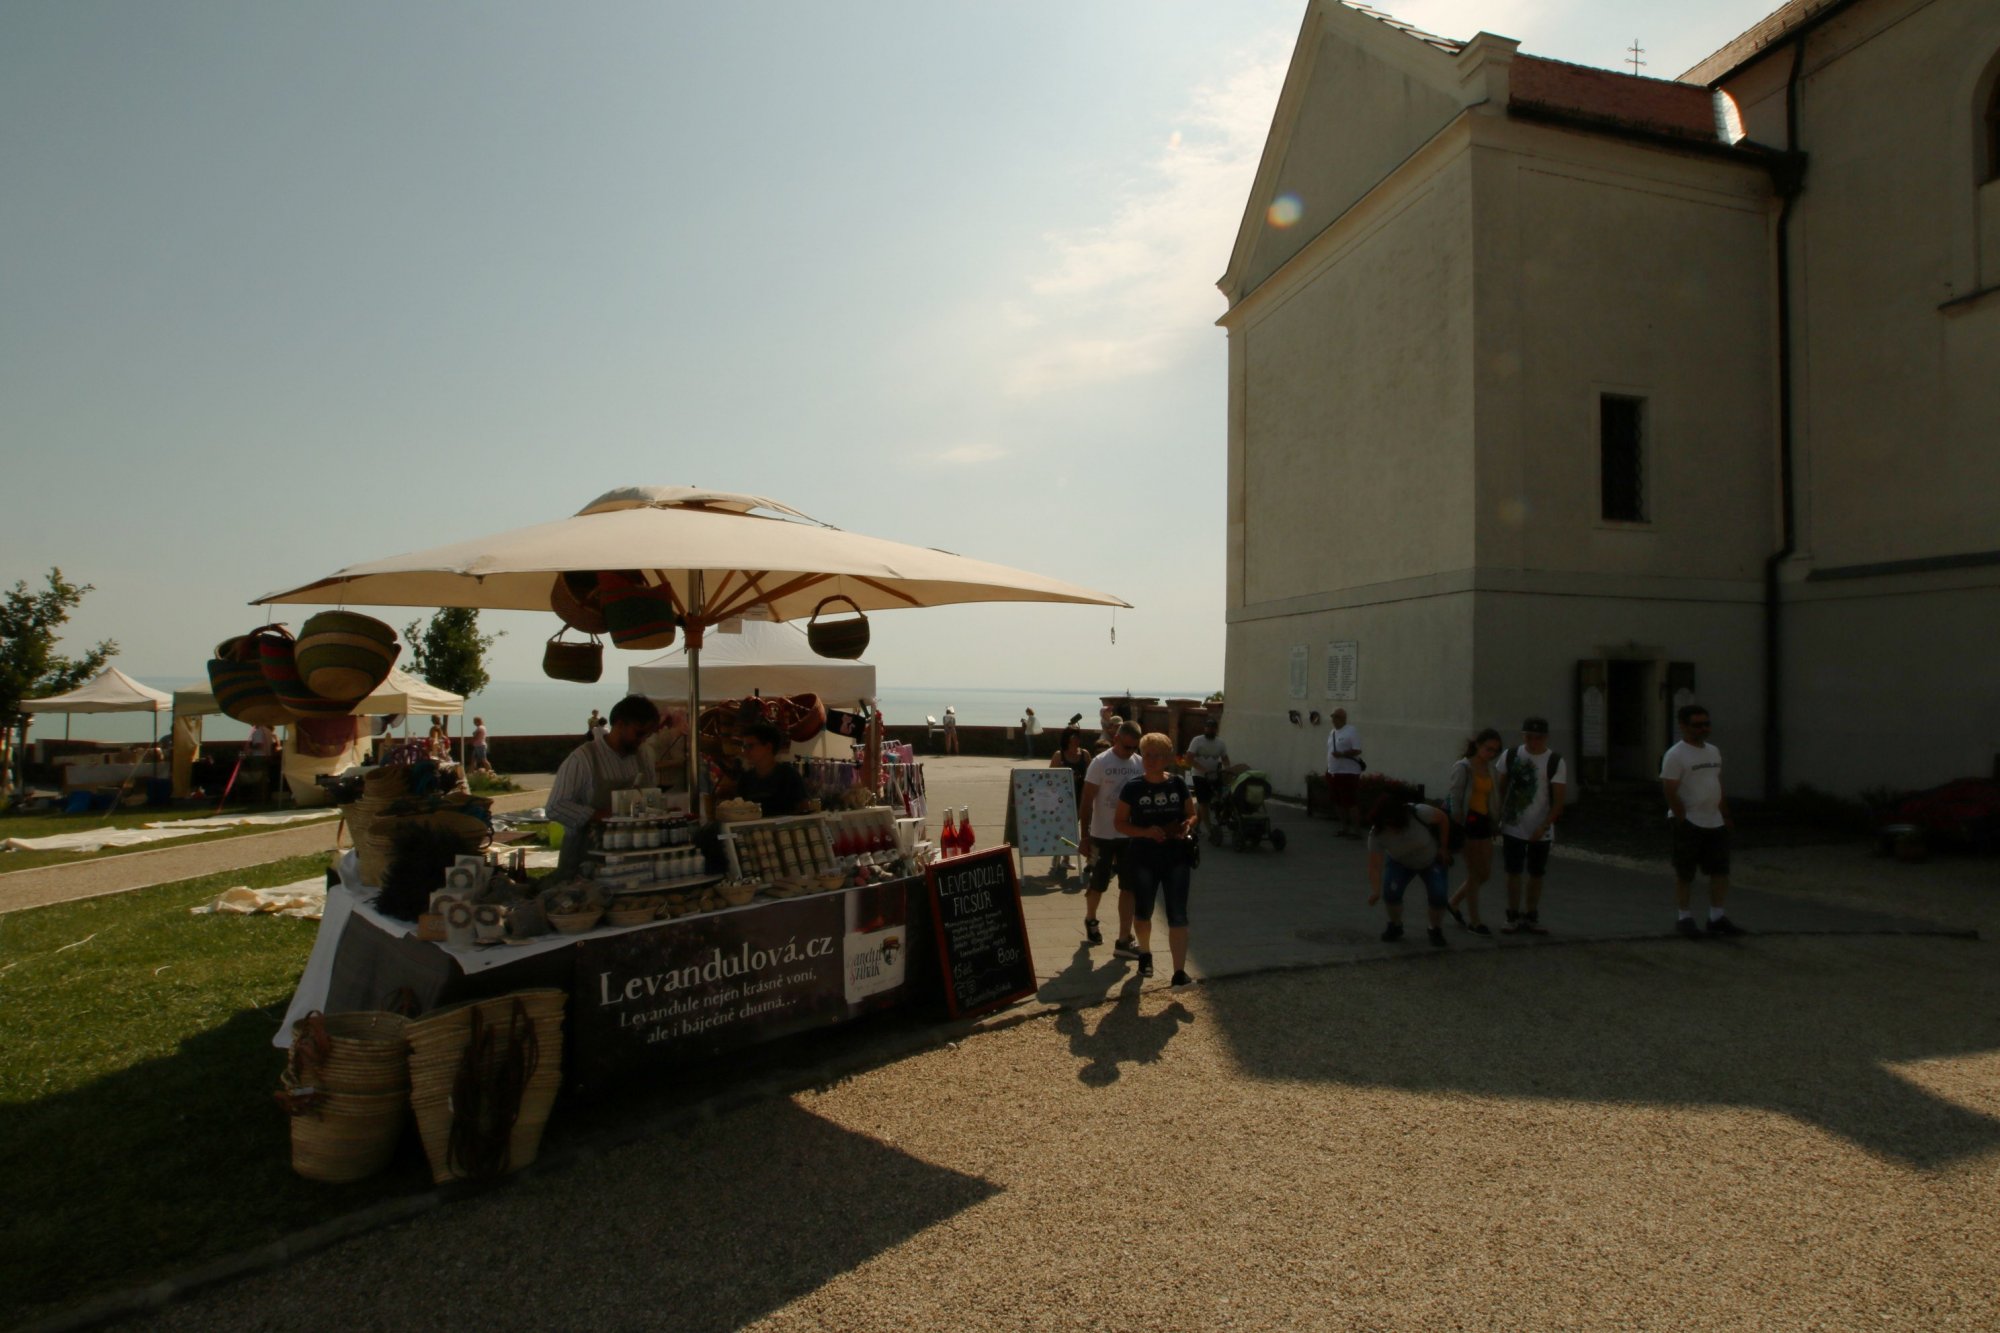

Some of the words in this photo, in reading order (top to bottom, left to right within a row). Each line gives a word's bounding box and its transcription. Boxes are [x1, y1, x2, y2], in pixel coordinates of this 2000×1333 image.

[938, 864, 1004, 897] LEVENDULA
[599, 935, 834, 1007] Levandulová.cz
[620, 996, 699, 1029] Levandule
[703, 987, 740, 1007] nejen
[743, 977, 784, 997] krásně
[786, 968, 817, 985] voní,
[647, 1026, 669, 1044] ale
[673, 1023, 678, 1037] i
[682, 1007, 735, 1034] báječně
